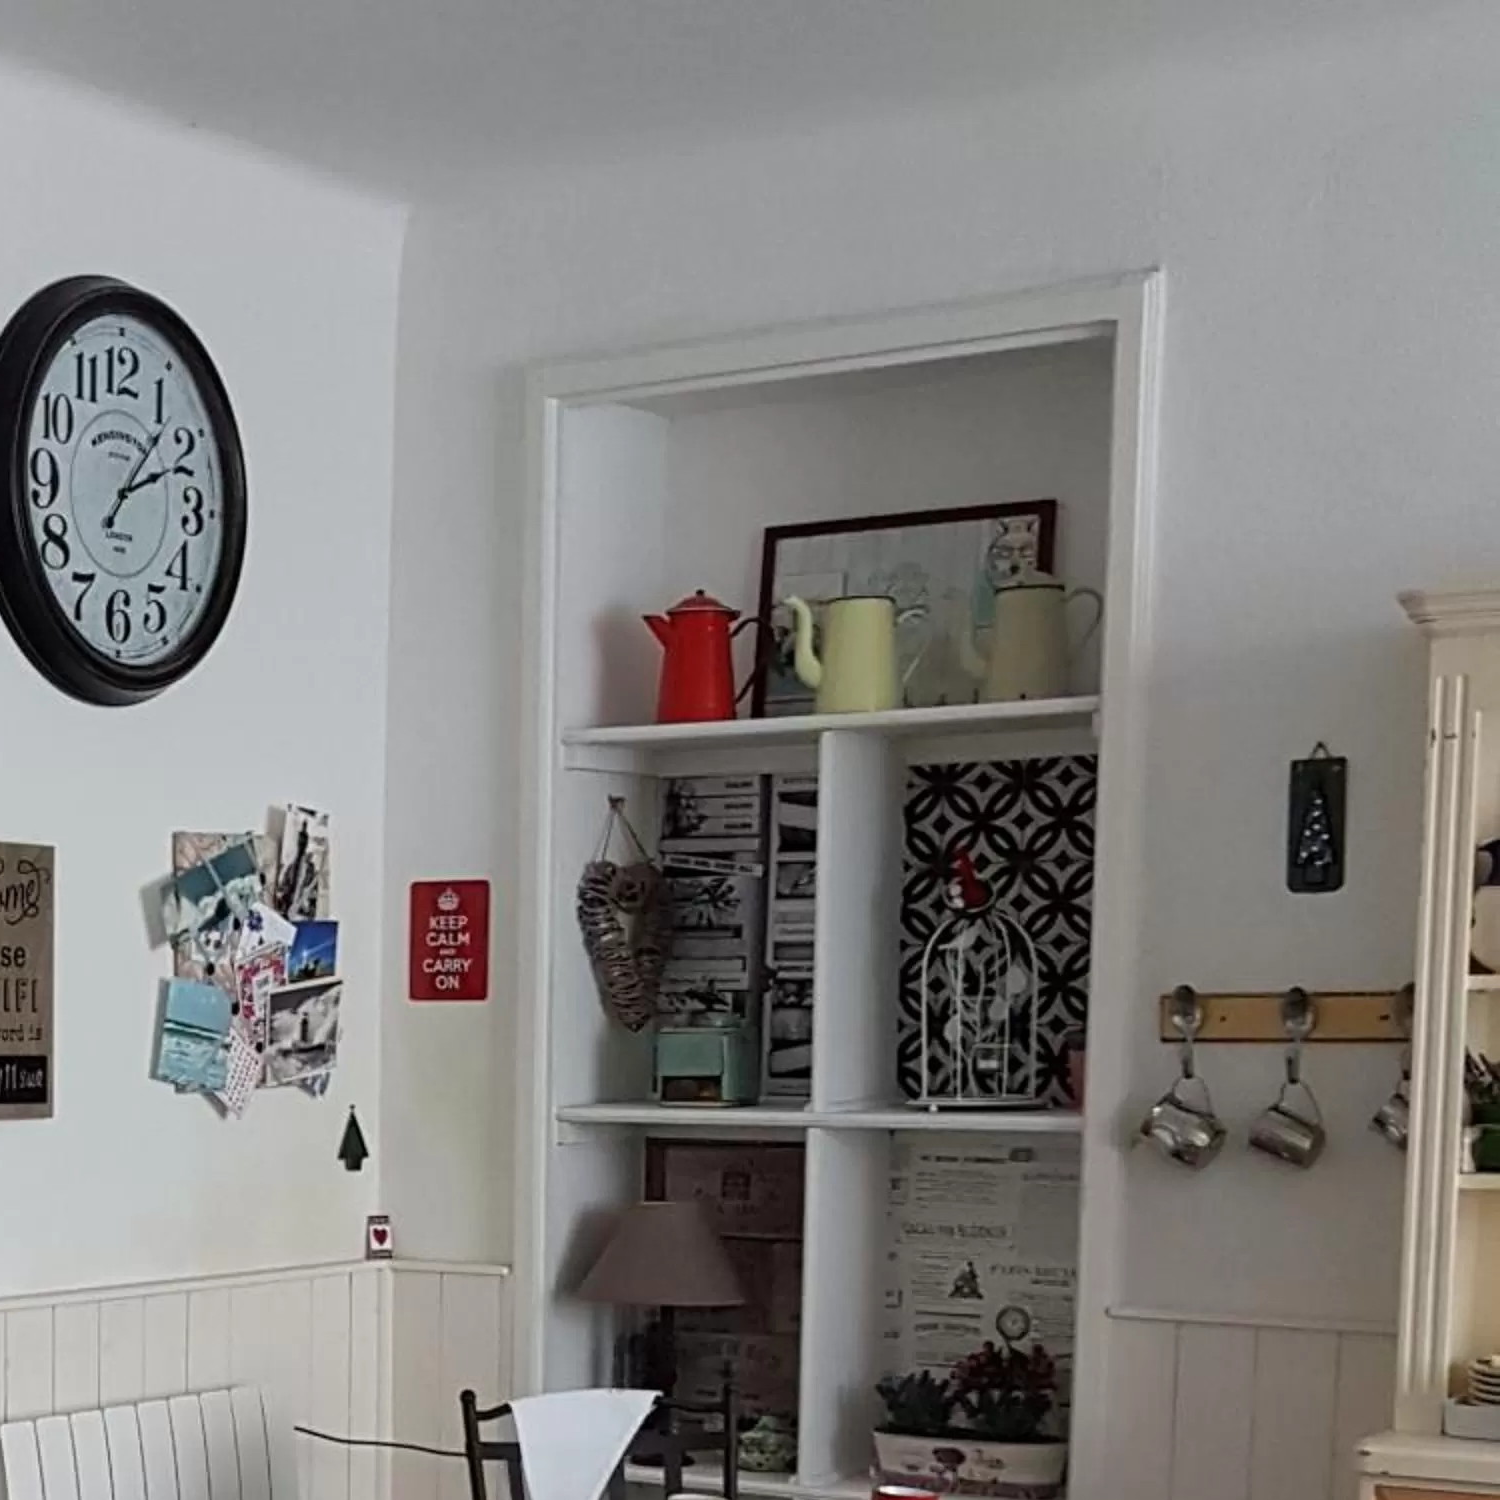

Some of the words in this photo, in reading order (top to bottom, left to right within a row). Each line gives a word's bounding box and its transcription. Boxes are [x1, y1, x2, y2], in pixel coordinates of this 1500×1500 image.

[74, 351, 99, 403] 11
[103, 345, 140, 400] 12
[42, 392, 74, 445] 10
[153, 377, 165, 425] 1
[172, 427, 195, 477] 2
[29, 447, 61, 509] 9
[181, 486, 205, 537] 3
[40, 513, 71, 570] 8
[164, 541, 190, 591] 4
[71, 573, 96, 622] 7
[104, 589, 132, 645] 6
[143, 583, 167, 634] 5
[425, 931, 471, 947] CALM
[429, 914, 469, 930] KEEP
[422, 957, 473, 974] CARRY
[435, 975, 461, 990] ON
